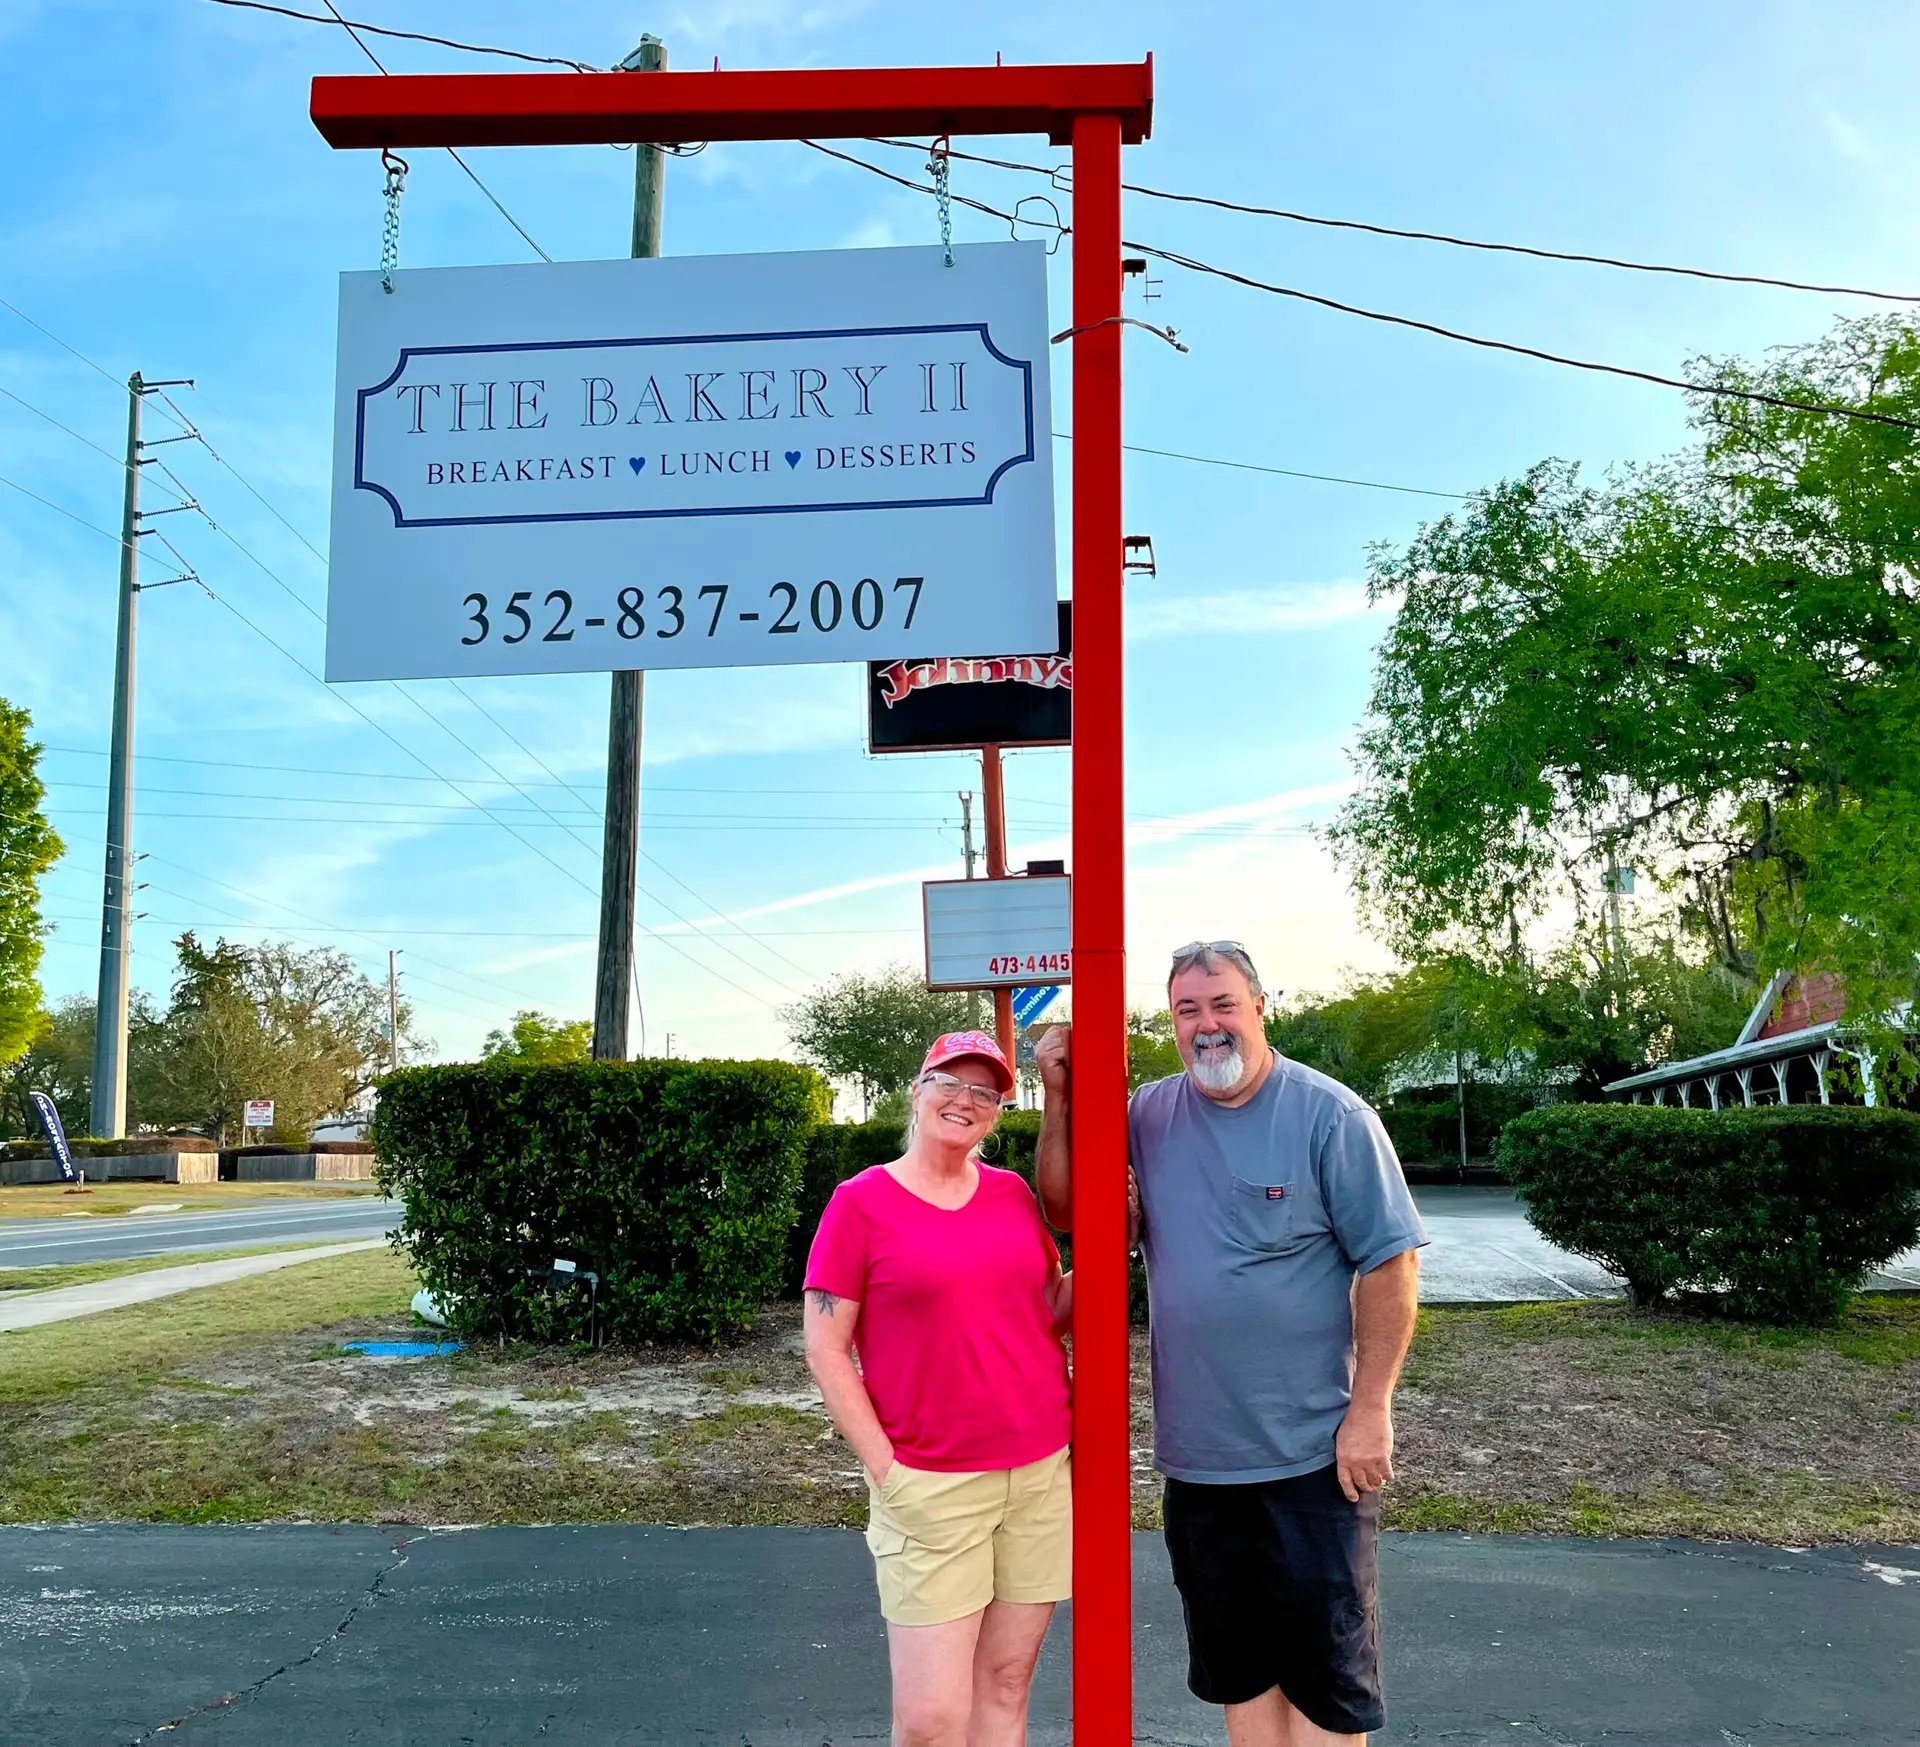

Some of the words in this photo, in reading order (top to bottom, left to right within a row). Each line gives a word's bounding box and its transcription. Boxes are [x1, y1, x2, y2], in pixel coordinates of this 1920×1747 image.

[396, 380, 549, 433] THE
[580, 364, 888, 427] BAKERY
[918, 361, 970, 413] II
[427, 456, 617, 485] BREAKFAST
[660, 449, 771, 476] LUNCH
[815, 441, 976, 470] DESSERTS
[461, 577, 925, 645] 352-837-2007
[36, 1096, 73, 1178] CHIROPRACTOR
